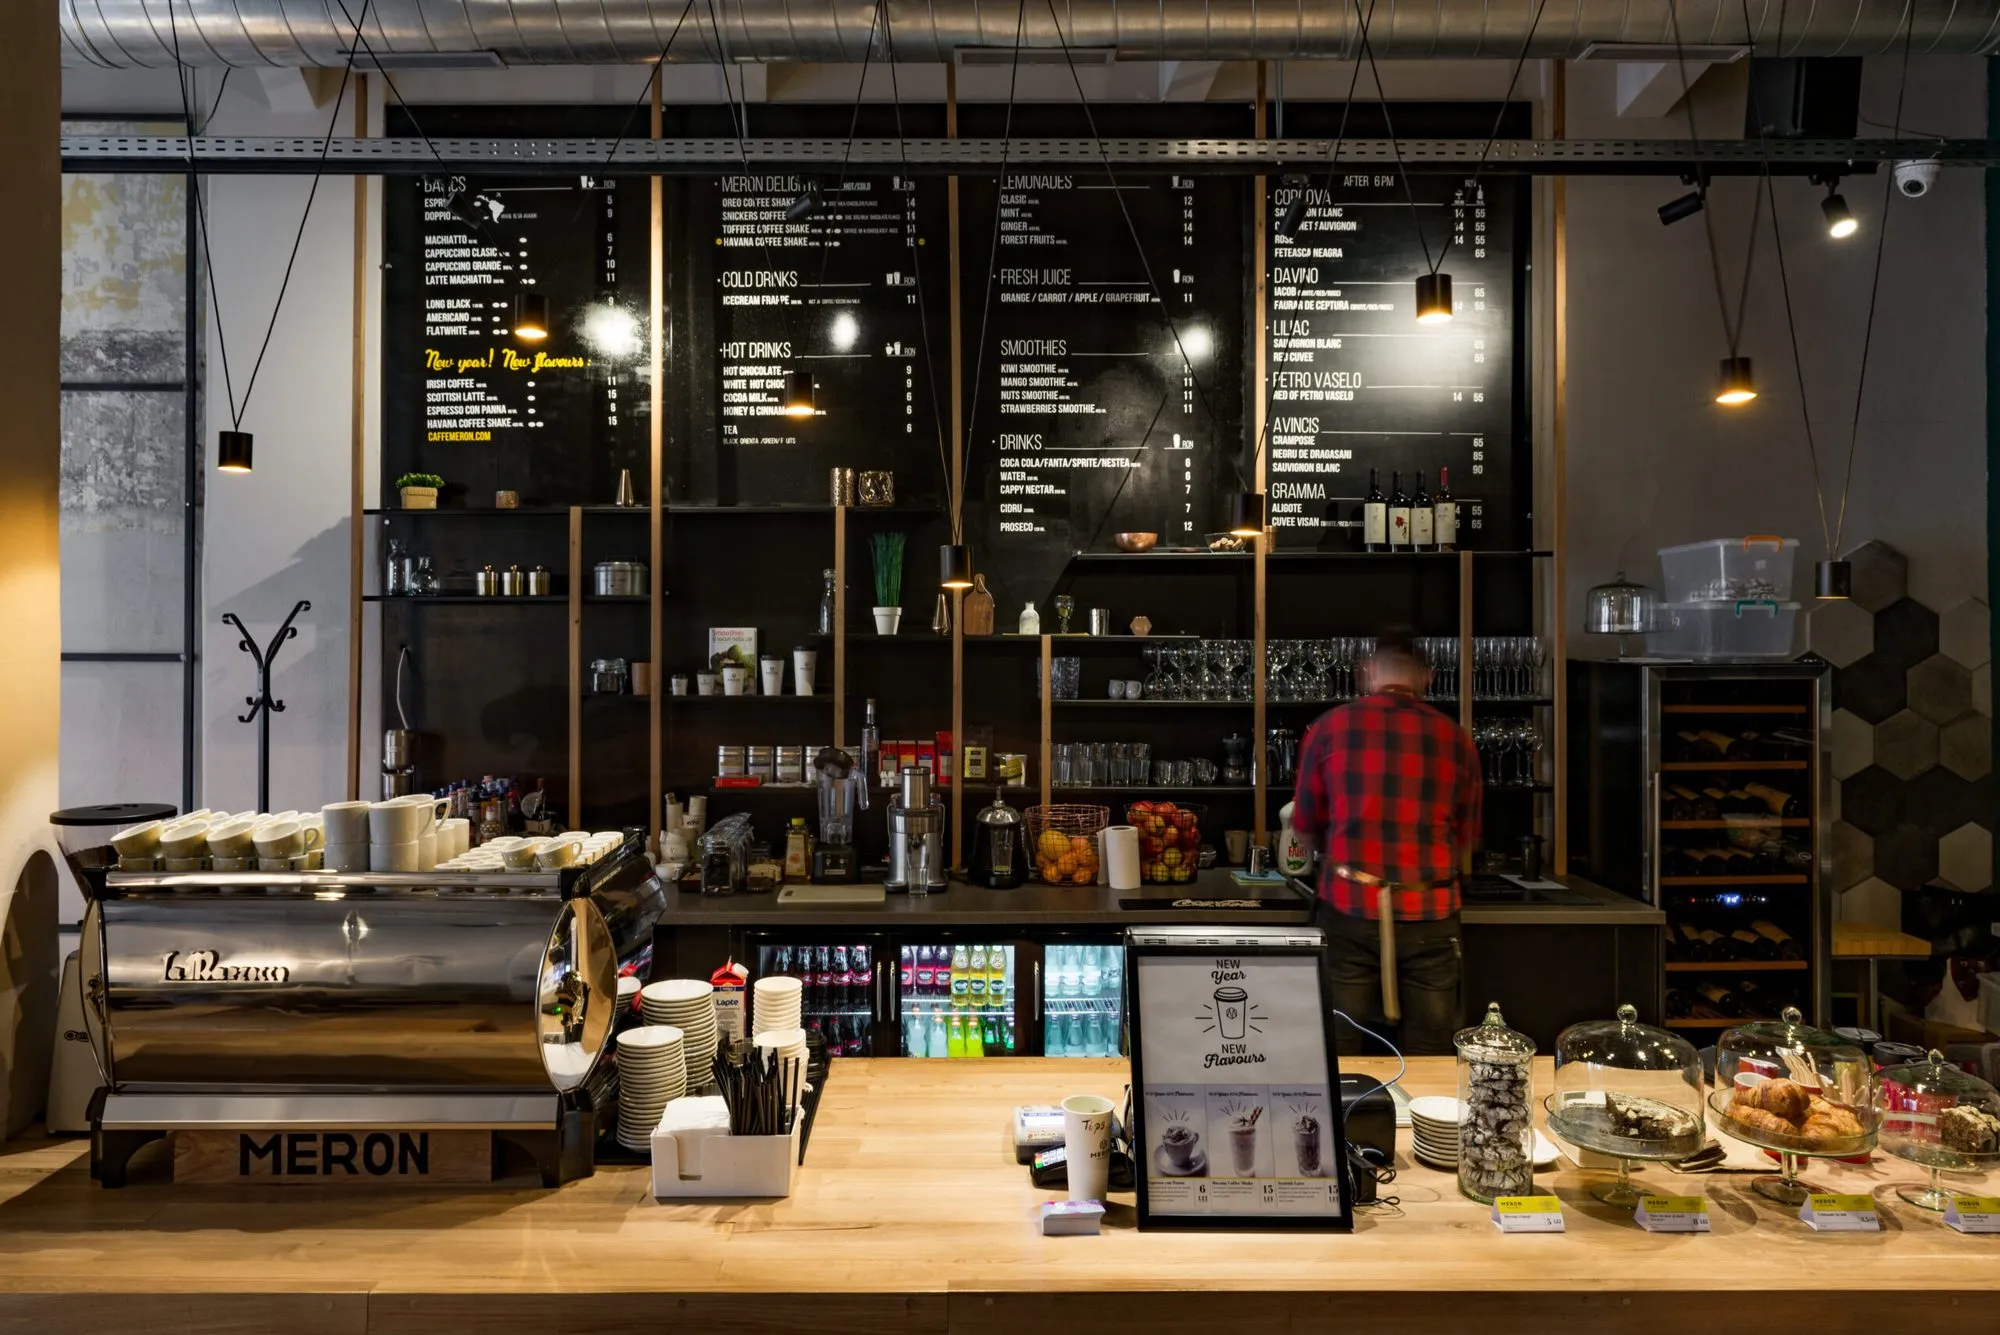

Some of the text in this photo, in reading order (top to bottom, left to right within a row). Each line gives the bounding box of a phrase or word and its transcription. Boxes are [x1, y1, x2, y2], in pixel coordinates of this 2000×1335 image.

[721, 176, 764, 192] MERON
[1344, 176, 1369, 187] AFTER
[722, 198, 741, 207] OREO
[1001, 195, 1193, 205] CLASIC 12
[425, 211, 451, 221] DOPPIO
[722, 211, 787, 220] SNICKERS COFFEE
[1001, 208, 1193, 219] MINT 14
[722, 224, 756, 234] TOFFIFEE
[785, 224, 810, 233] SHAKE
[1001, 221, 1193, 232] GINGER 14
[425, 235, 467, 244] MACHIATTO
[723, 237, 754, 246] HAVANA
[783, 237, 808, 246] SHAKE
[1001, 235, 1028, 244] FOREST
[1030, 235, 1055, 244] FRUITS
[1184, 236, 1193, 245] 14
[1454, 235, 1464, 245] 14
[425, 248, 497, 258] CAPPUCCINO CLASIC
[1313, 248, 1343, 258] NEAGRA
[1475, 248, 1485, 258] 65
[425, 259, 615, 271] CAPPUCCINO GRANDE 10
[426, 276, 448, 285] LATTE
[449, 275, 492, 284] MACHIATTO
[606, 272, 615, 282] 11
[722, 271, 753, 288] COLD
[1000, 269, 1038, 285] FRESH
[1041, 269, 1071, 285] JUICE
[1274, 268, 1318, 284] DAVINO
[1274, 287, 1296, 296] IACOB
[723, 295, 916, 305] ICECREAM 11
[1001, 293, 1193, 303] ORANGE CARROT APPLE GRAPEFRUIT 11
[426, 299, 470, 309] LONG BLACK
[1305, 300, 1314, 310] DE
[1316, 300, 1349, 310] CEPTURA
[426, 313, 469, 322] AMERICANO
[426, 326, 467, 335] FLATWHITE
[1000, 339, 1067, 356] SMOOTHIES
[1317, 339, 1341, 348] BLANC
[723, 342, 791, 359] HOT DRINKS
[425, 349, 455, 370] New
[458, 348, 494, 373] year!
[502, 349, 531, 370] New
[1289, 352, 1314, 362] CUVEE
[723, 366, 782, 376] HOT CHOCOLATE
[1001, 364, 1056, 373] KIWI SMOOTHIE
[426, 376, 616, 389] IRISH COFFEE 11
[723, 379, 747, 389] WHITE
[749, 379, 765, 389] HOT
[1001, 377, 1192, 387] MANGO SMOOTHIE 11
[1273, 371, 1362, 388] PETRO VASELO
[427, 389, 617, 402] SCOTTISH LATTE 15
[723, 393, 767, 402] COCOA MILK
[1001, 391, 1192, 400] NUTS SMOOTHIE 11
[1289, 391, 1299, 400] OF
[1300, 391, 1324, 400] PETRO
[1325, 391, 1354, 400] VASELO
[1453, 392, 1462, 402] 14
[427, 405, 506, 415] ESPRESSO CON PANNA
[723, 406, 748, 416] HONEY
[1000, 404, 1192, 414] STRAWBERRIES SMOOTHIE 11
[427, 419, 457, 429] HAVANA
[458, 419, 486, 428] COFFEE
[487, 418, 511, 427] SHAKE
[608, 416, 617, 426] 15
[1273, 417, 1320, 433] AVINCIS
[723, 425, 738, 434] TEA
[428, 432, 491, 441] CAFFEMERON.COM
[1000, 434, 1042, 450] DRINKS
[1273, 436, 1484, 448] CRAMPOSIE 65
[1272, 450, 1297, 459] NEGRU
[1298, 450, 1309, 459] DE
[1310, 450, 1352, 459] DRAGASANI
[1000, 458, 1130, 468] COCA COLA/FANTA/SPRITE/NESTEA
[1272, 463, 1483, 475] SAUVIGNON BLANC 90
[1000, 472, 1026, 481] WATER
[1000, 485, 1024, 495] CAPPY
[1025, 485, 1054, 495] NECTAR
[1272, 483, 1326, 500] GRAMMA
[1000, 504, 1022, 513] CIDRU
[1272, 504, 1482, 515] ALIGOTE 55
[1000, 523, 1033, 532] PROSECO
[1184, 522, 1192, 531] 12
[1272, 517, 1298, 527] CUVEE
[1298, 517, 1319, 527] VISAN
[1216, 960, 1241, 969] NEW
[1211, 970, 1247, 985] Year
[716, 999, 739, 1007] Lapte
[1221, 1044, 1246, 1054] NEW
[1203, 1053, 1267, 1069] Flavours
[1082, 1120, 1105, 1135] Tips
[240, 1132, 429, 1176] MERON
